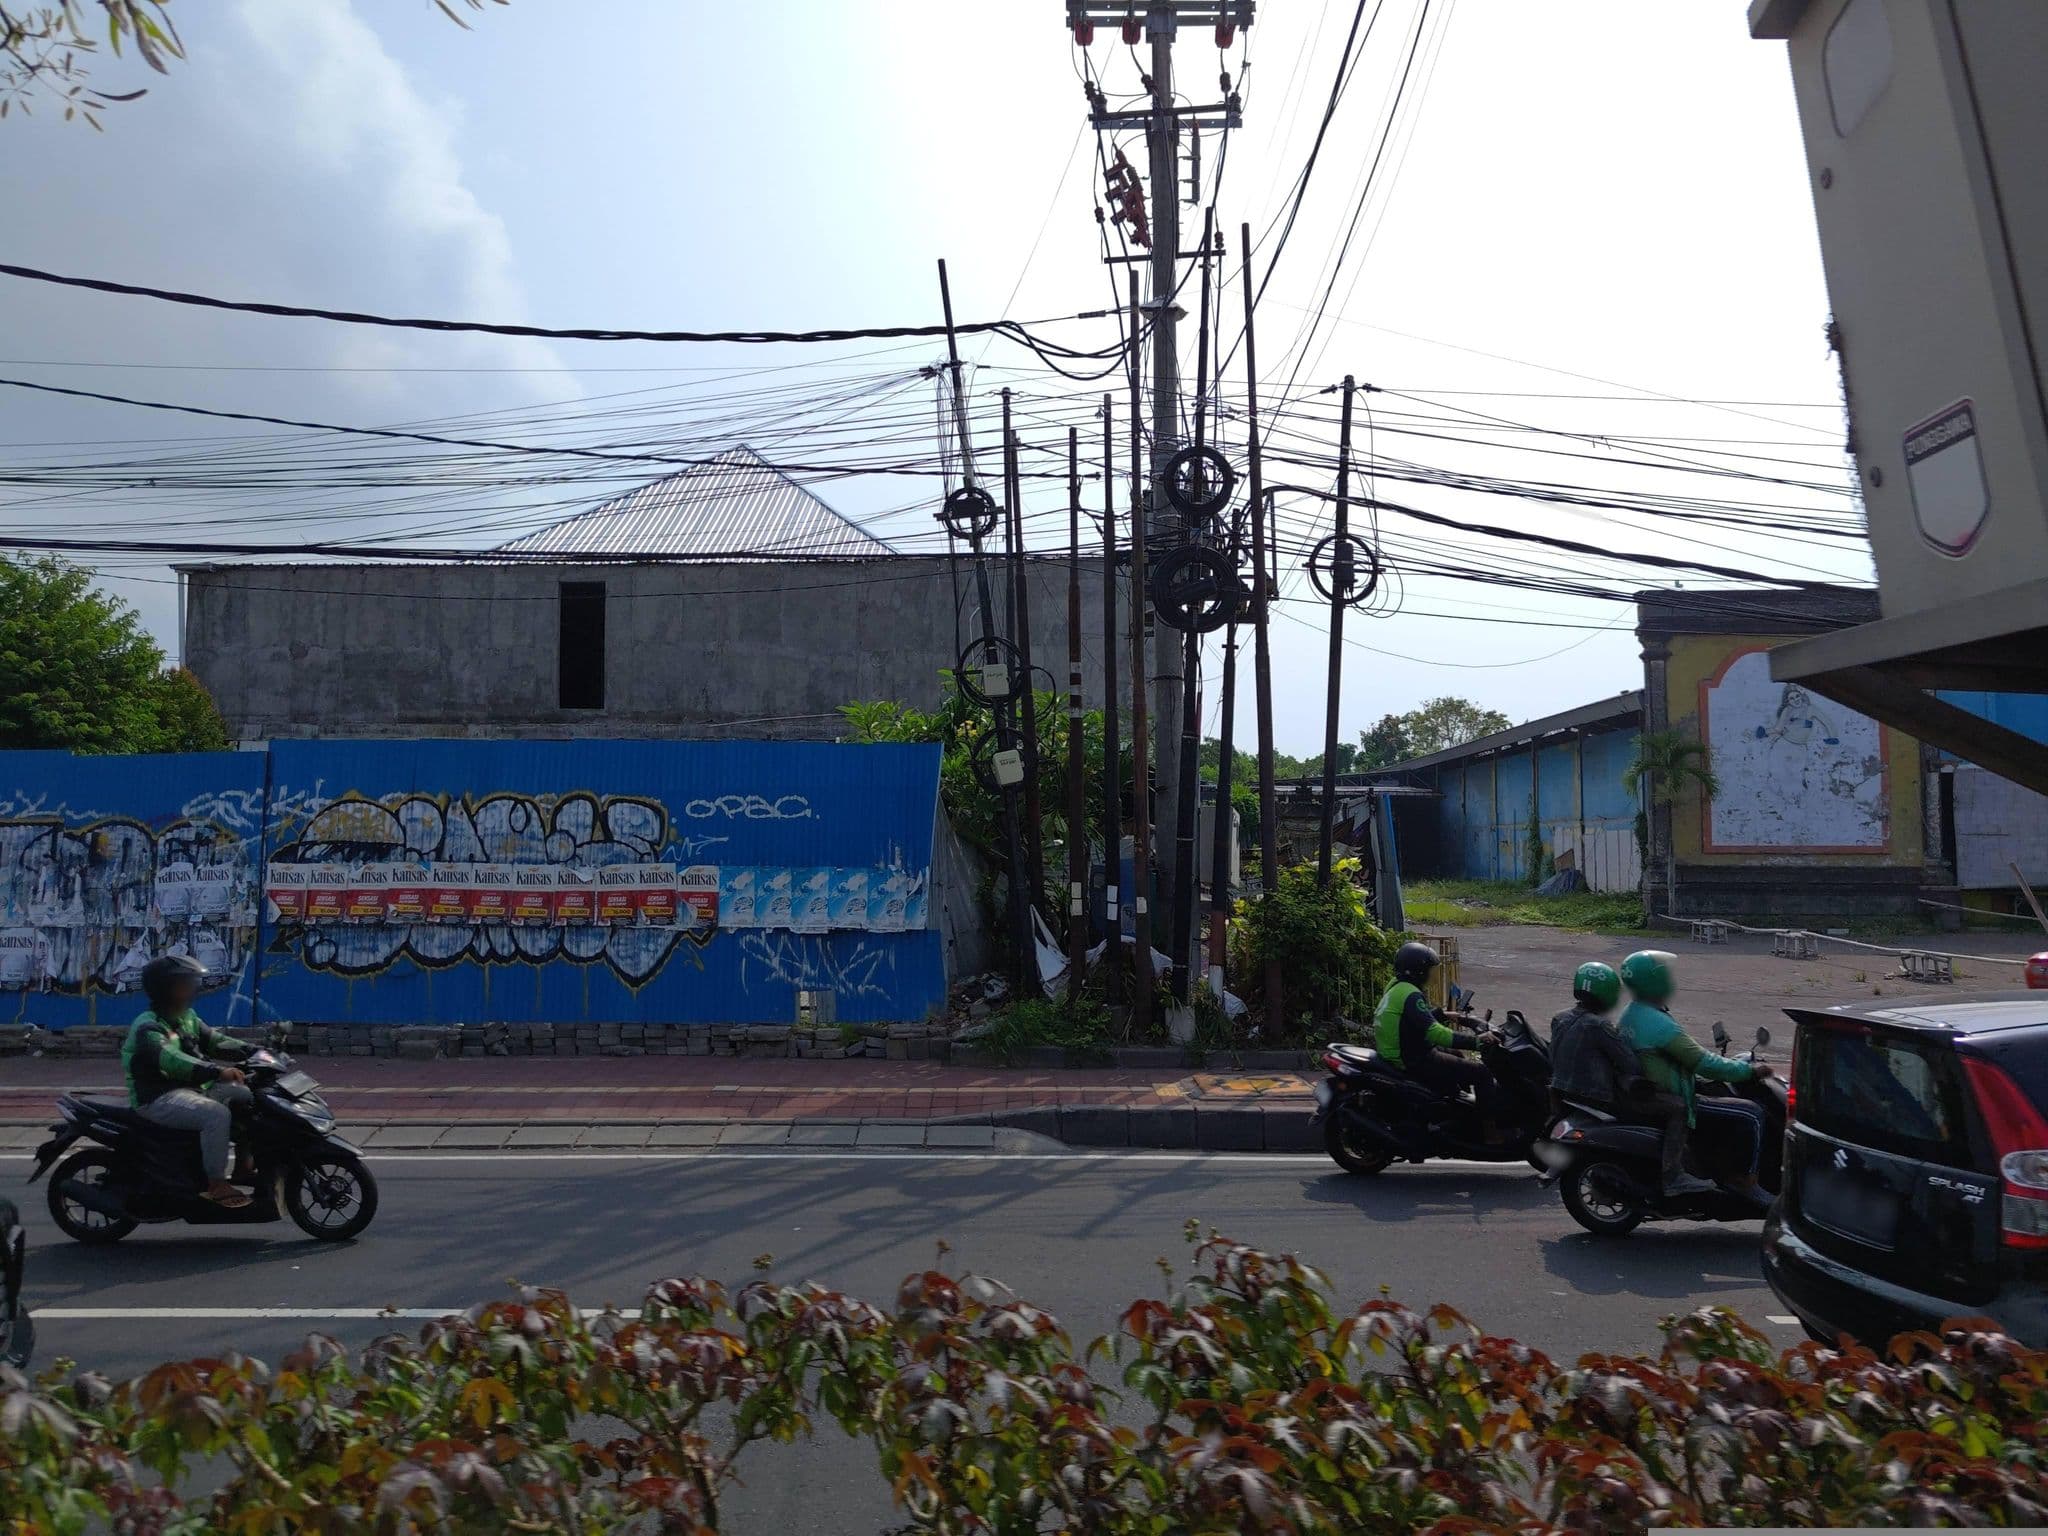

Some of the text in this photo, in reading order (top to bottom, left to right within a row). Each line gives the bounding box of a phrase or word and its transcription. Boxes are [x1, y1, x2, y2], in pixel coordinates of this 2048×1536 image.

[270, 870, 305, 884] Kansas
[310, 870, 345, 884] Kansas
[392, 869, 428, 882] Kansas
[433, 869, 470, 883] Kansas
[474, 870, 510, 884] Kansas
[516, 871, 552, 885] Kansas
[600, 871, 635, 885] Kansas
[639, 870, 674, 884] Kansas
[1928, 1176, 1986, 1196] SPLASH
